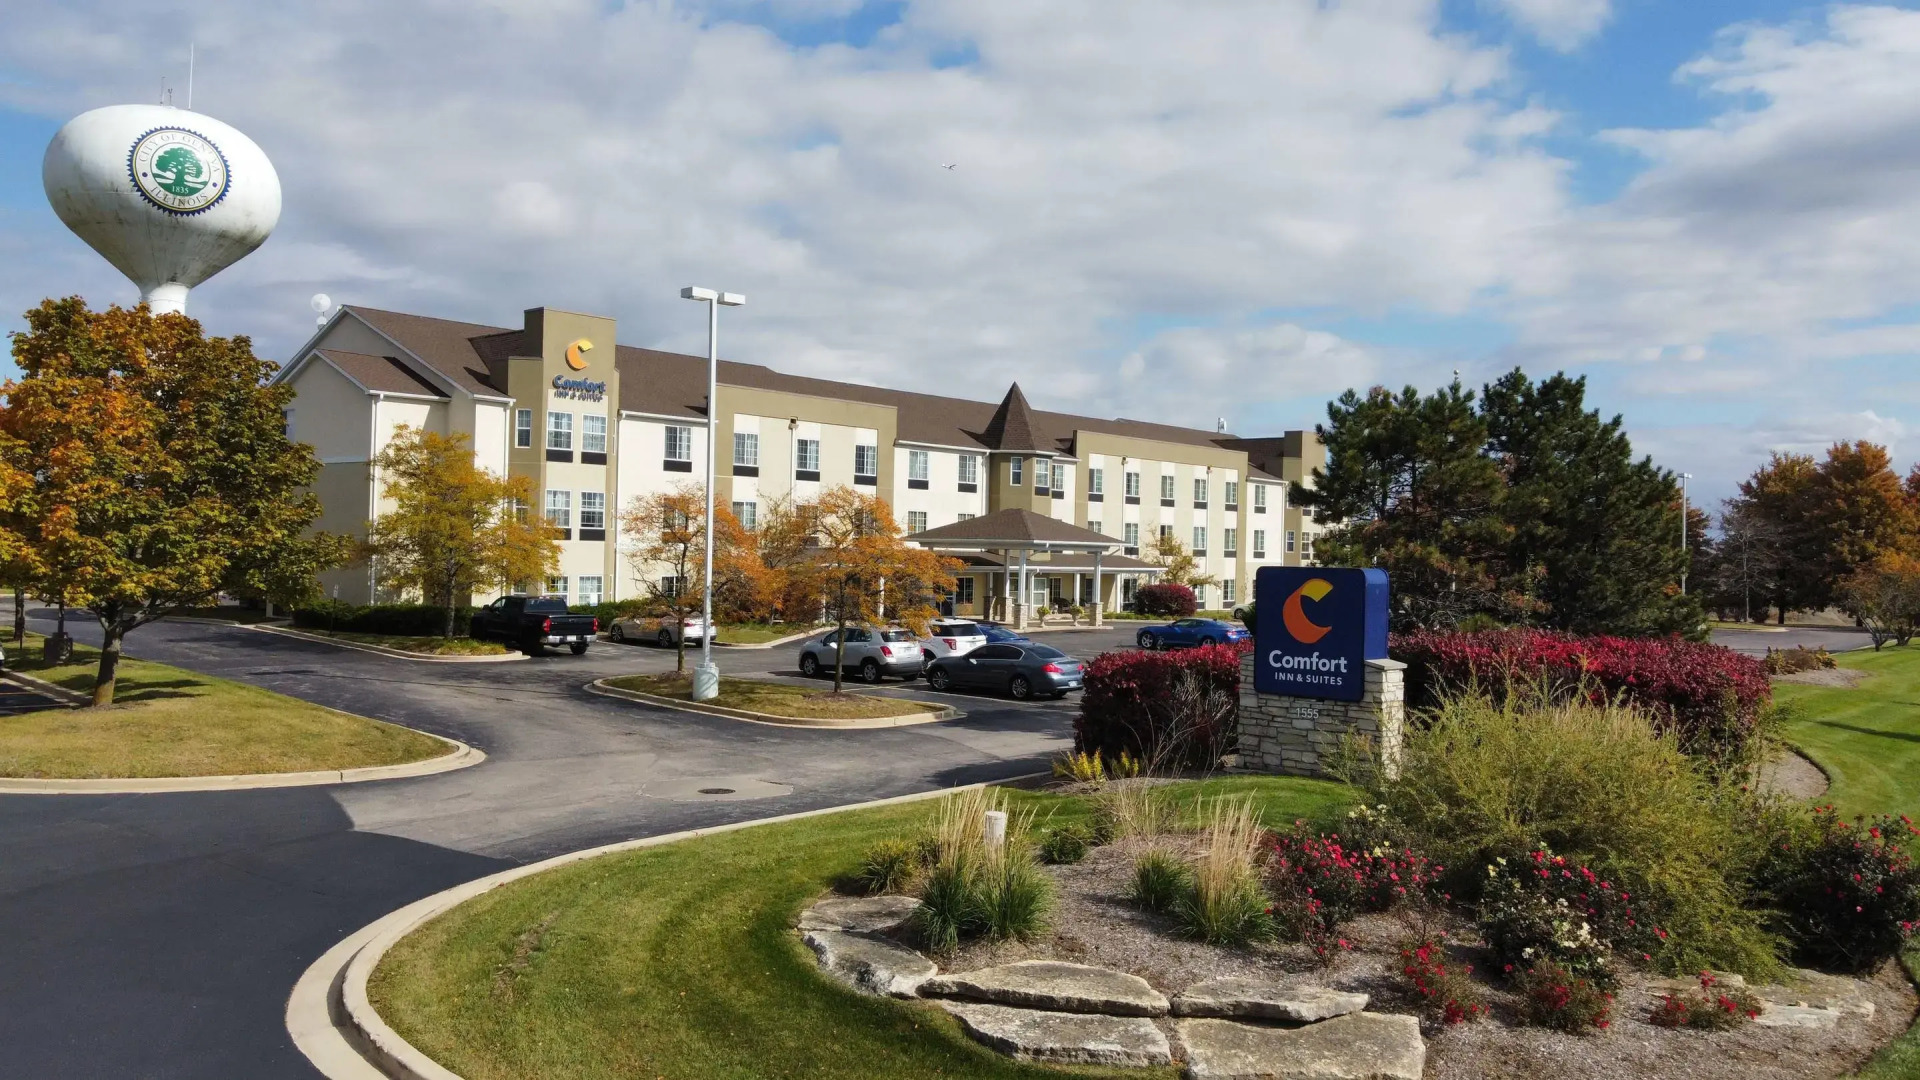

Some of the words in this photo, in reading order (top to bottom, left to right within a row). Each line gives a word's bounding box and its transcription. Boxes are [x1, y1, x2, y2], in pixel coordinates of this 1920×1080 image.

[139, 139, 158, 162] CITY
[182, 135, 220, 172] GENVA
[150, 186, 208, 206] ILLINOIS
[171, 185, 189, 194] 1835
[552, 374, 606, 393] Comfort
[1269, 649, 1348, 673] Comfort
[1275, 672, 1294, 681] INN
[1296, 673, 1303, 682] &
[1306, 674, 1342, 685] SUITES
[1296, 708, 1319, 719] 1555
